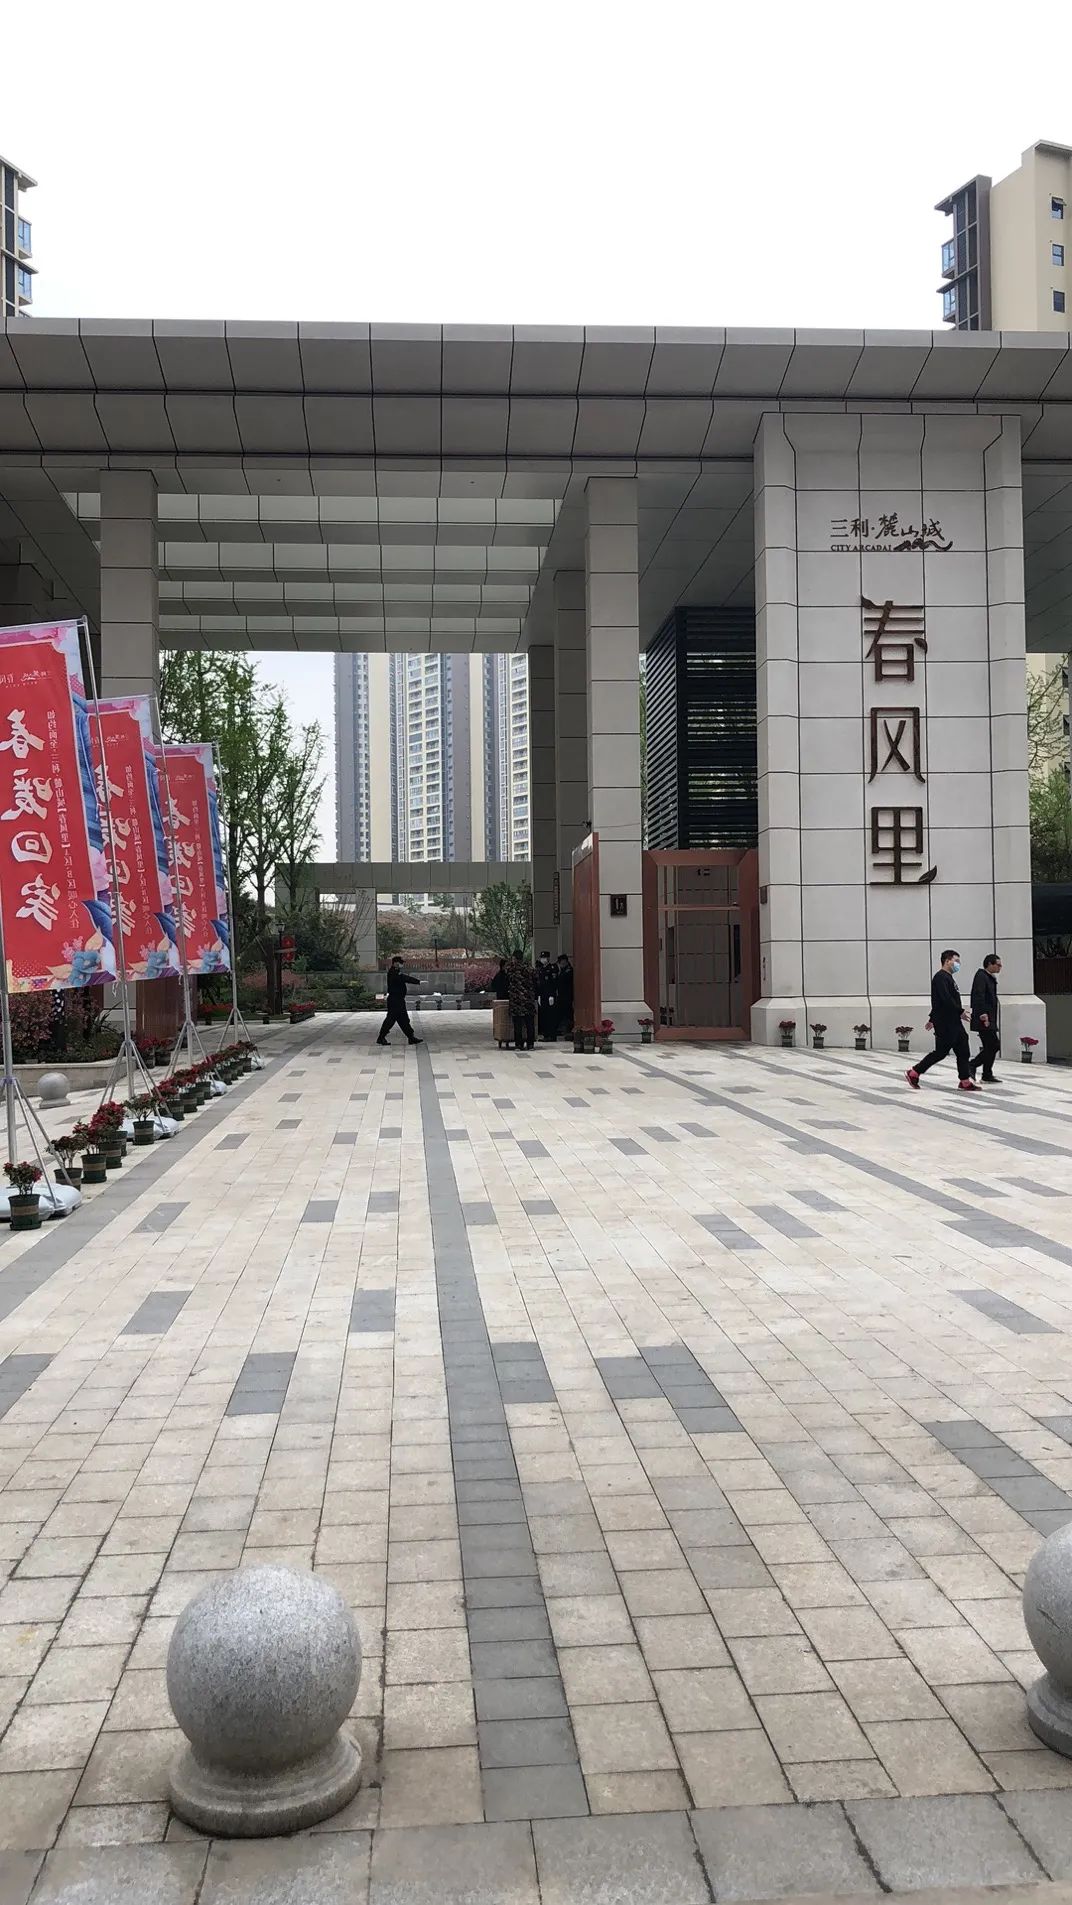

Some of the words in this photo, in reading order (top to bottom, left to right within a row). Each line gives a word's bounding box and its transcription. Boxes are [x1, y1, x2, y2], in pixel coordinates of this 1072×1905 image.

[831, 544, 851, 552] CITY
[860, 595, 937, 886] 春风里
